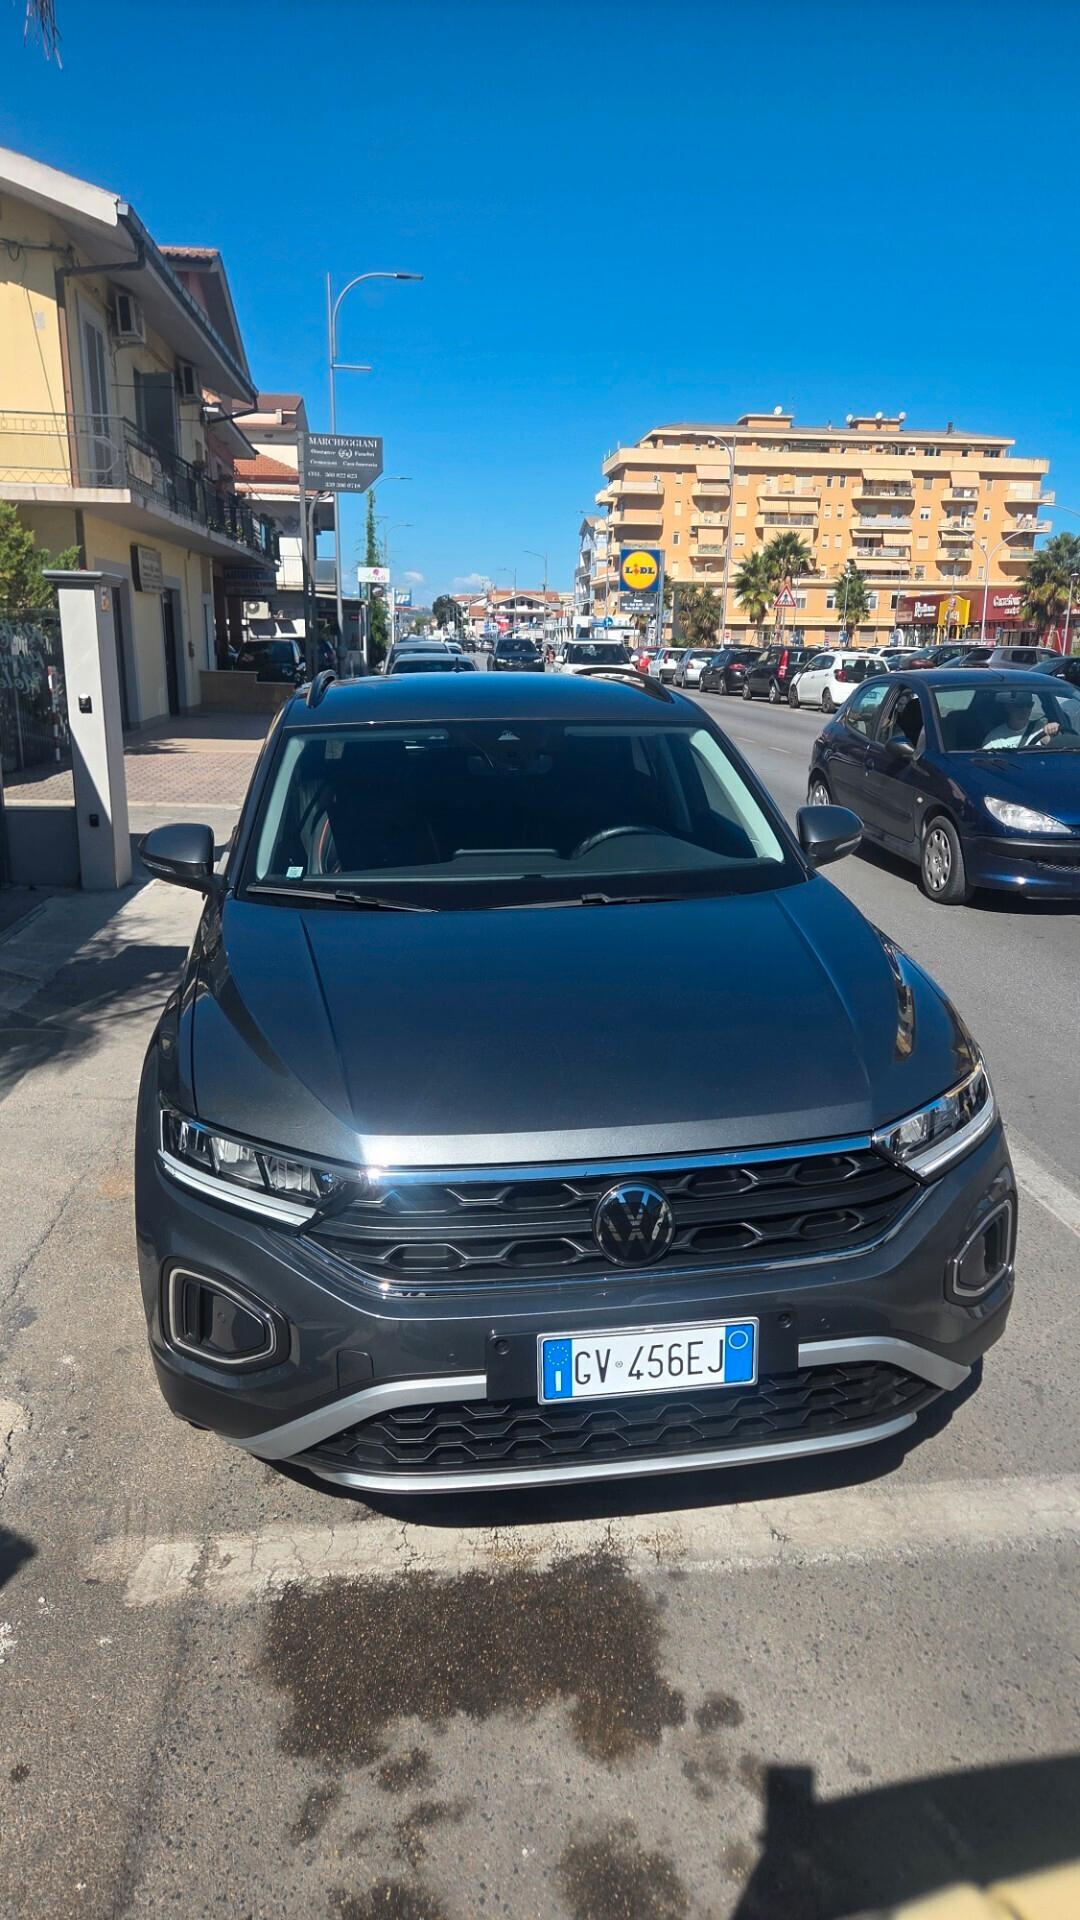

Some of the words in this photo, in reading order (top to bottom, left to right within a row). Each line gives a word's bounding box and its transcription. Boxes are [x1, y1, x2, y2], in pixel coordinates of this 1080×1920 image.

[308, 437, 377, 448] MARCHEGGIANI
[396, 594, 410, 604] IP
[555, 1370, 562, 1392] I
